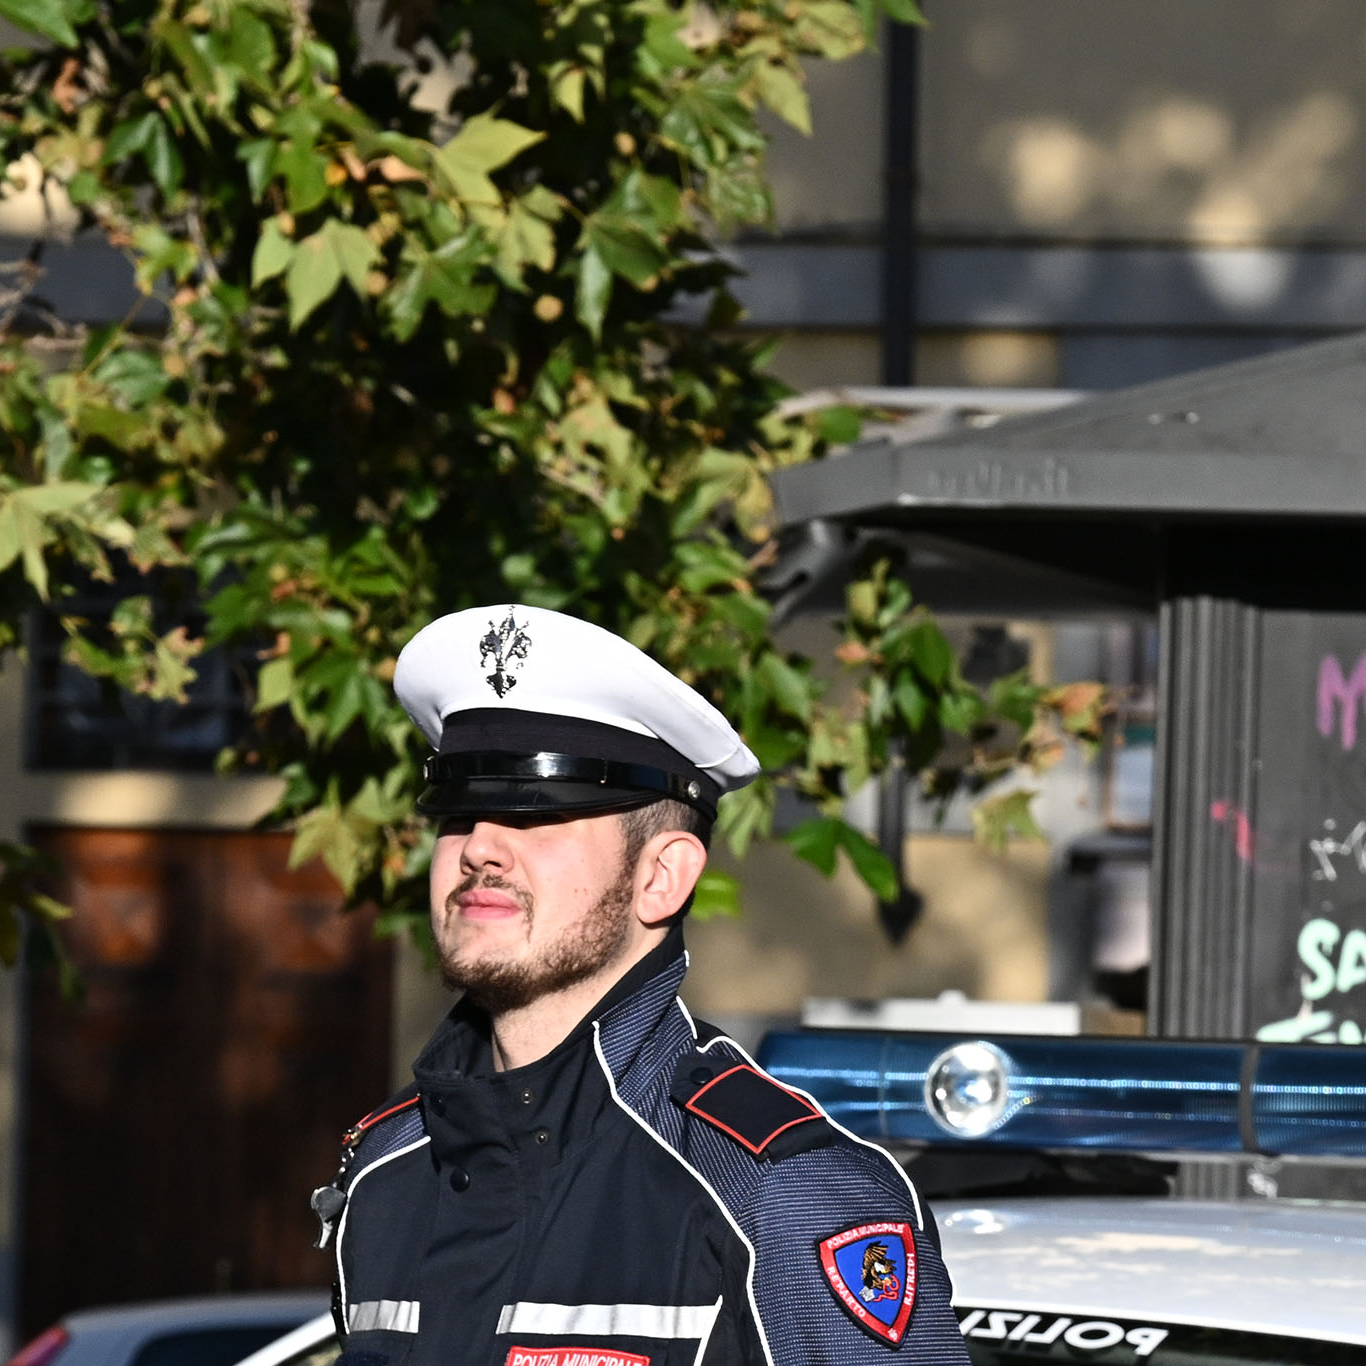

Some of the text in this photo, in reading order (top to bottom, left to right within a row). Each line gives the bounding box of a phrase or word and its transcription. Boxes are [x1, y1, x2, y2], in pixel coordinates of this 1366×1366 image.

[827, 1223, 905, 1249] POLIZIA MUNICIPALE
[827, 1266, 866, 1318] REPARTO
[904, 1253, 915, 1306] RIFREDI
